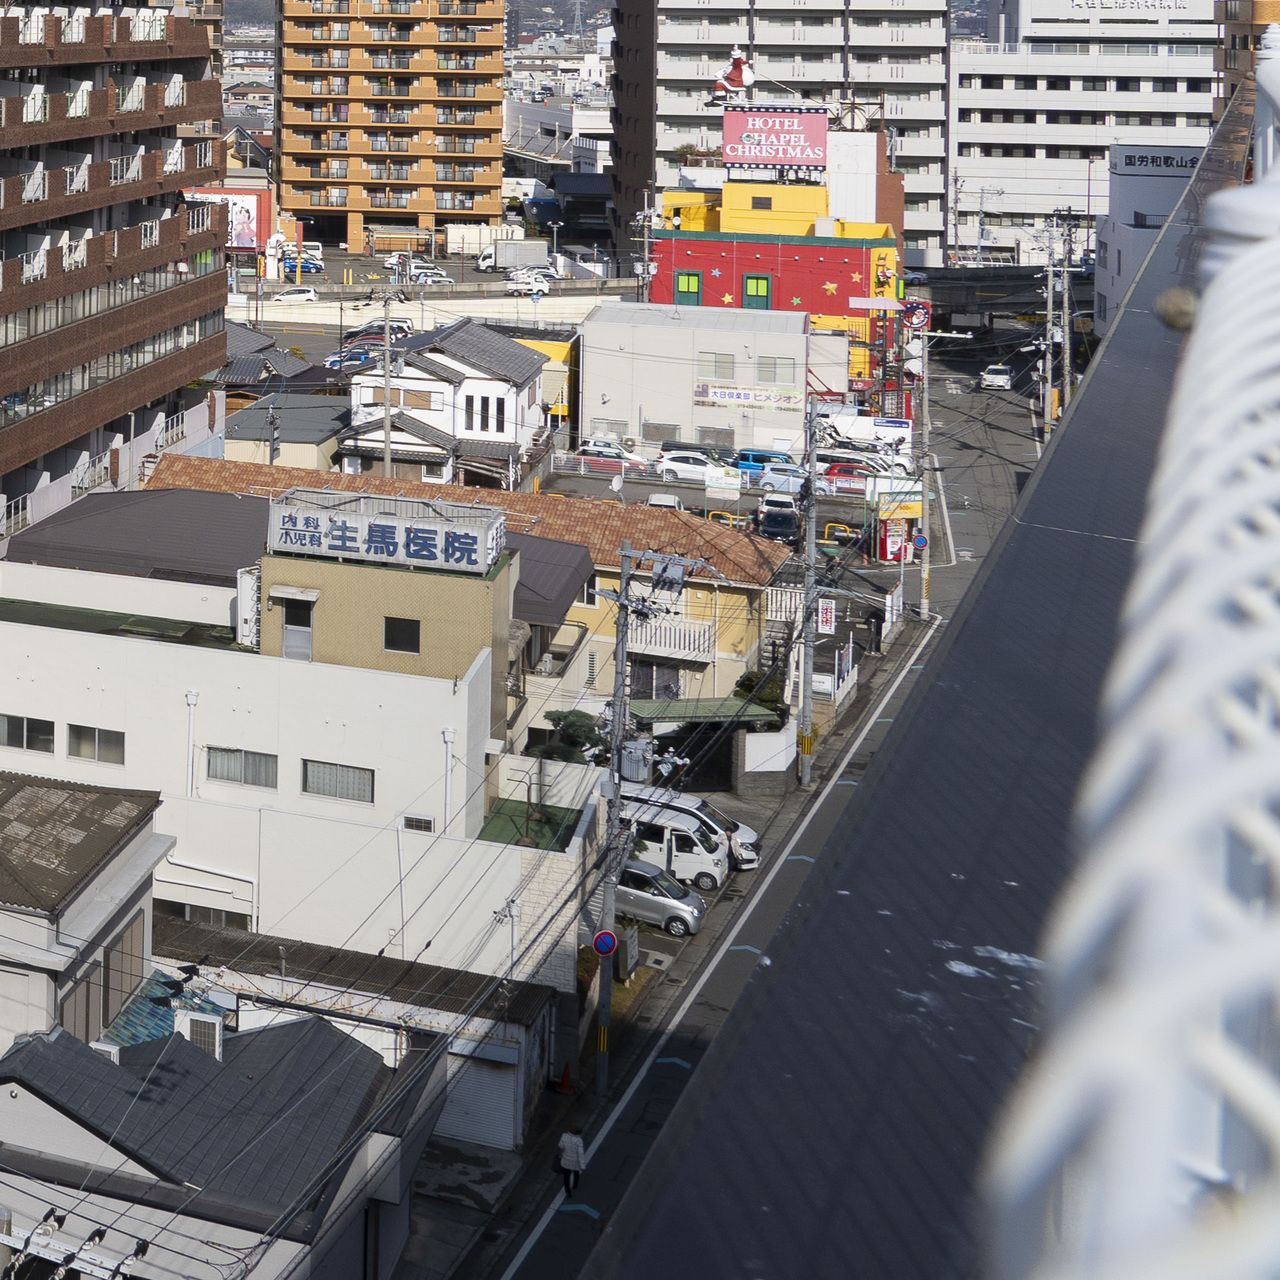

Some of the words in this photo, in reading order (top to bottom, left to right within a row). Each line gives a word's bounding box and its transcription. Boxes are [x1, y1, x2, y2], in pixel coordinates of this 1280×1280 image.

[746, 117, 804, 130] HOTEL
[741, 132, 810, 146] CHAPEL
[725, 143, 824, 159] CHRISTMAS
[281, 514, 321, 530] 内科
[278, 531, 323, 548] 小児科
[327, 520, 479, 567] 生馬医院
